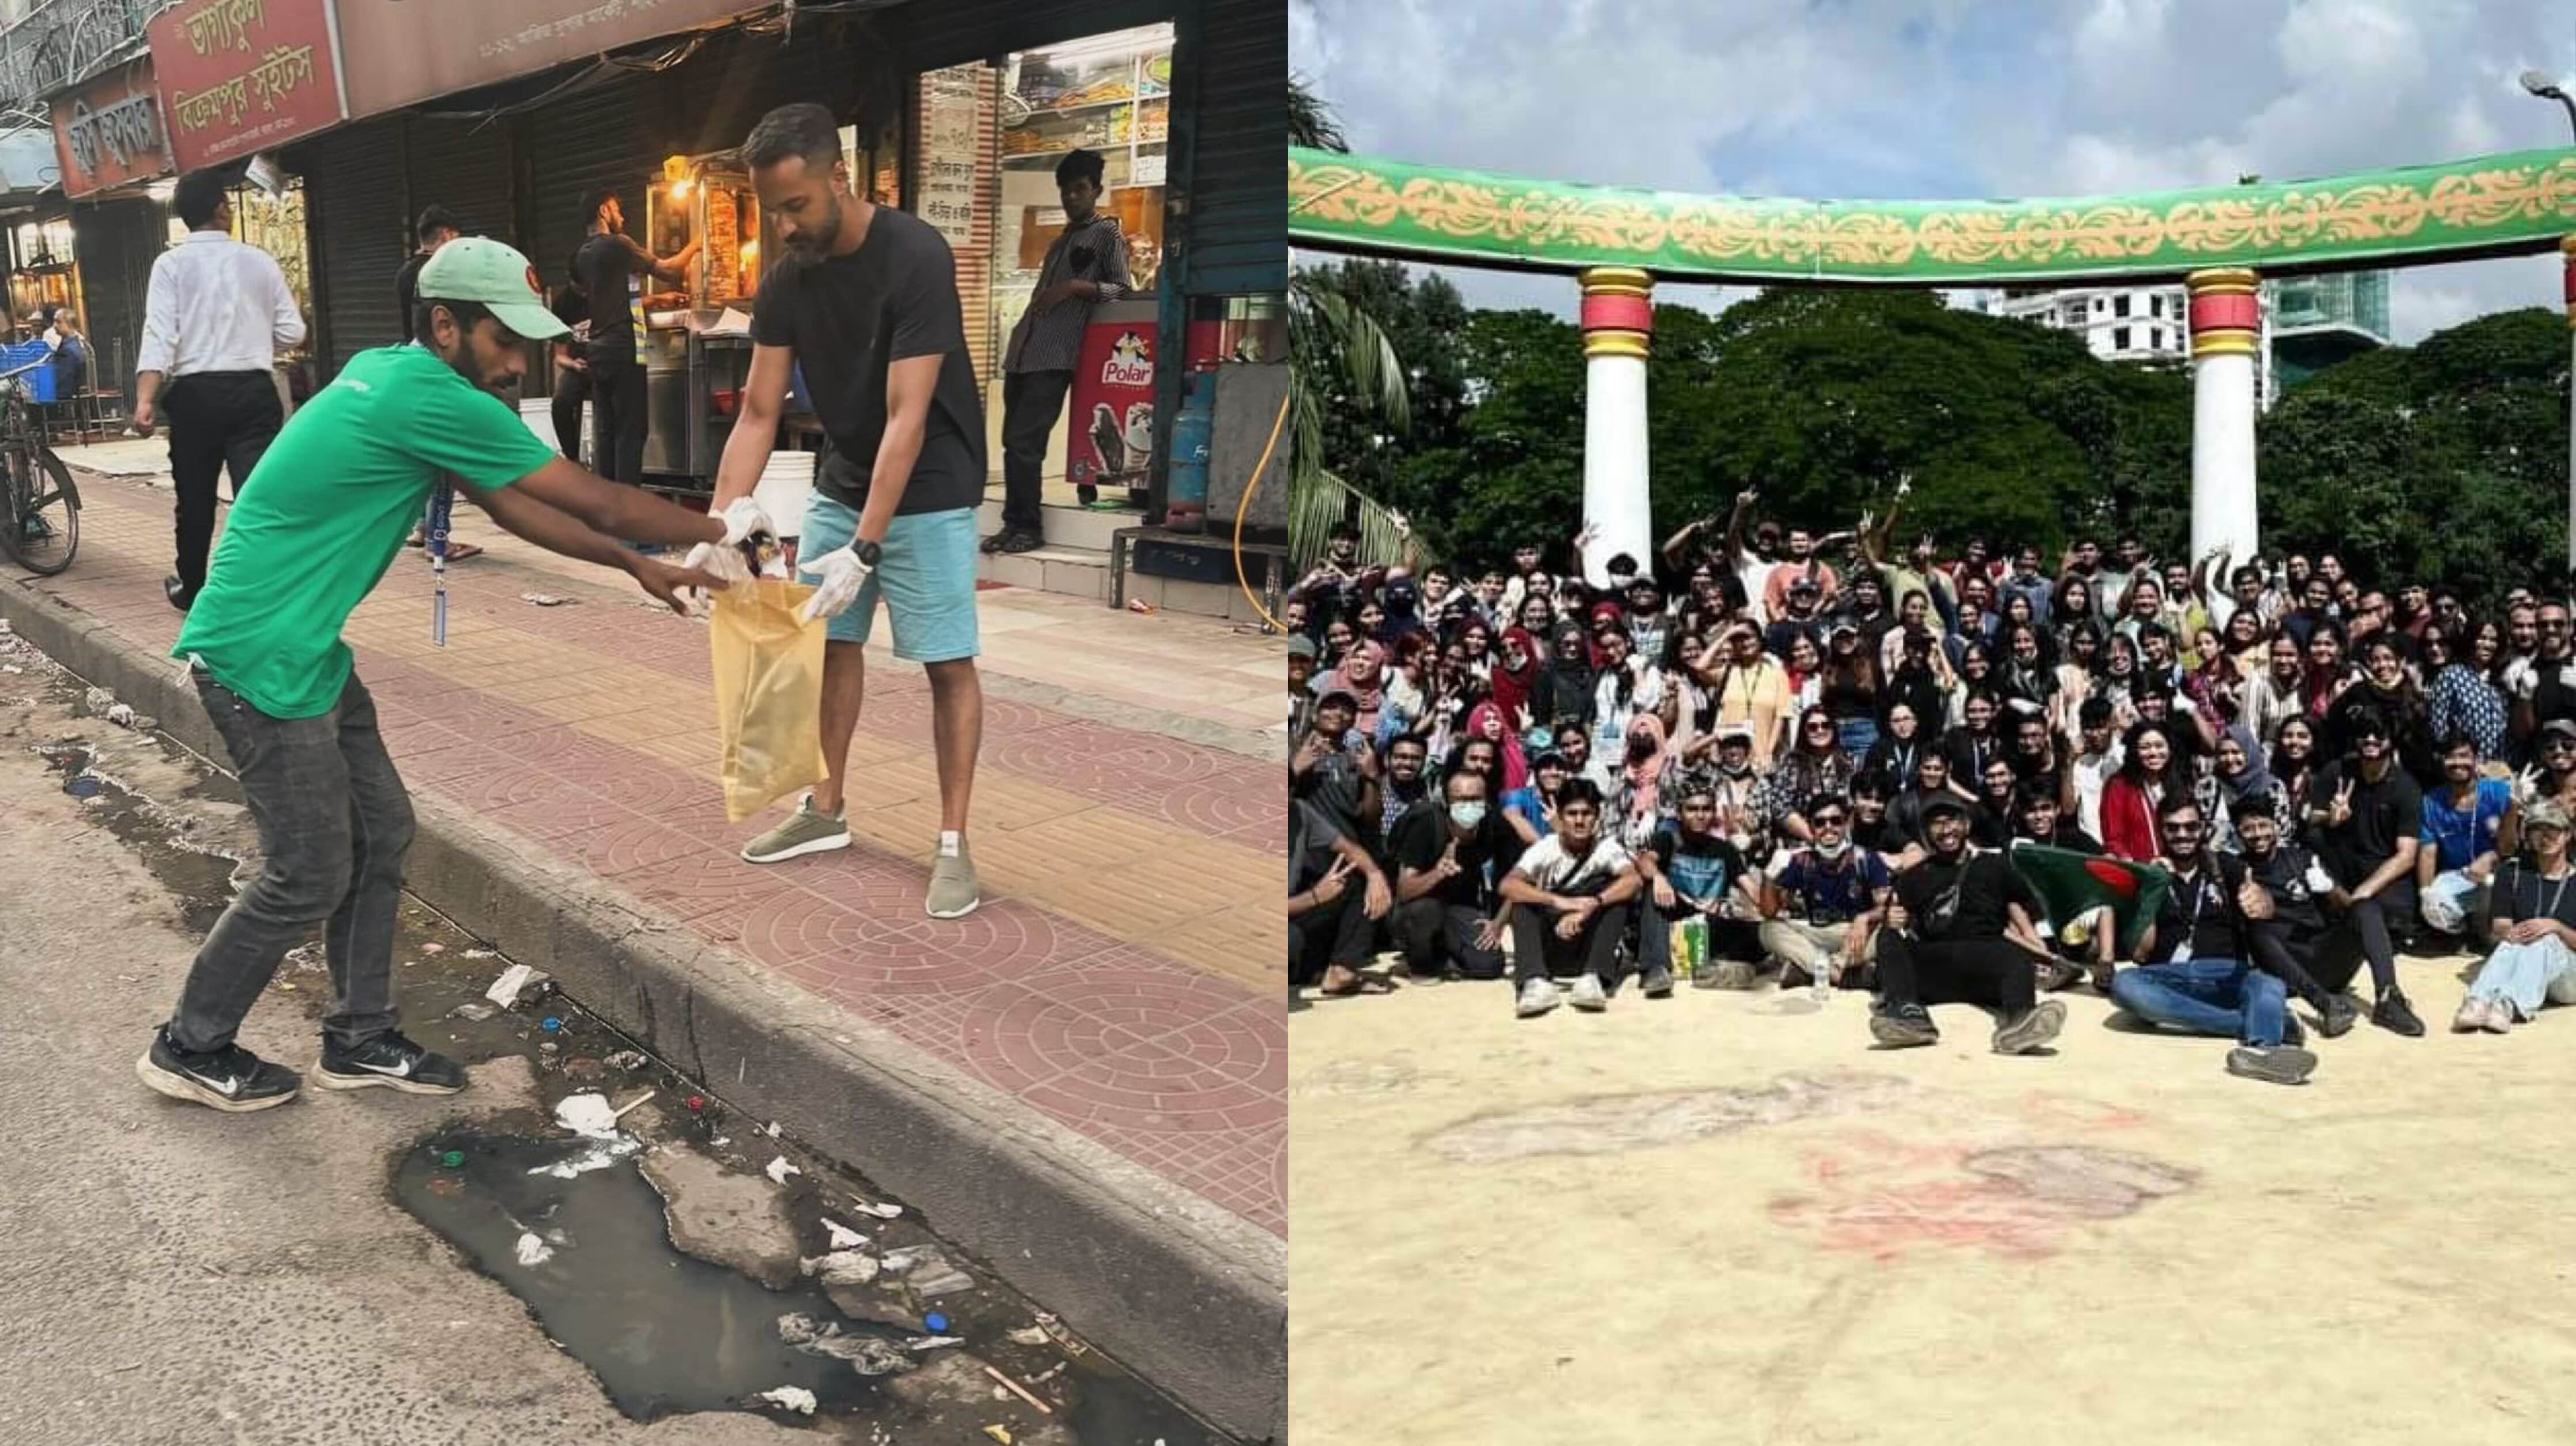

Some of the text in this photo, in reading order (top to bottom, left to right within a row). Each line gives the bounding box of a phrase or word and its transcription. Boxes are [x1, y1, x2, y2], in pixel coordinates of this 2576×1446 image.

[174, 45, 313, 136] বিক্রমপুর সুইটস
[1105, 362, 1151, 382] Polar
